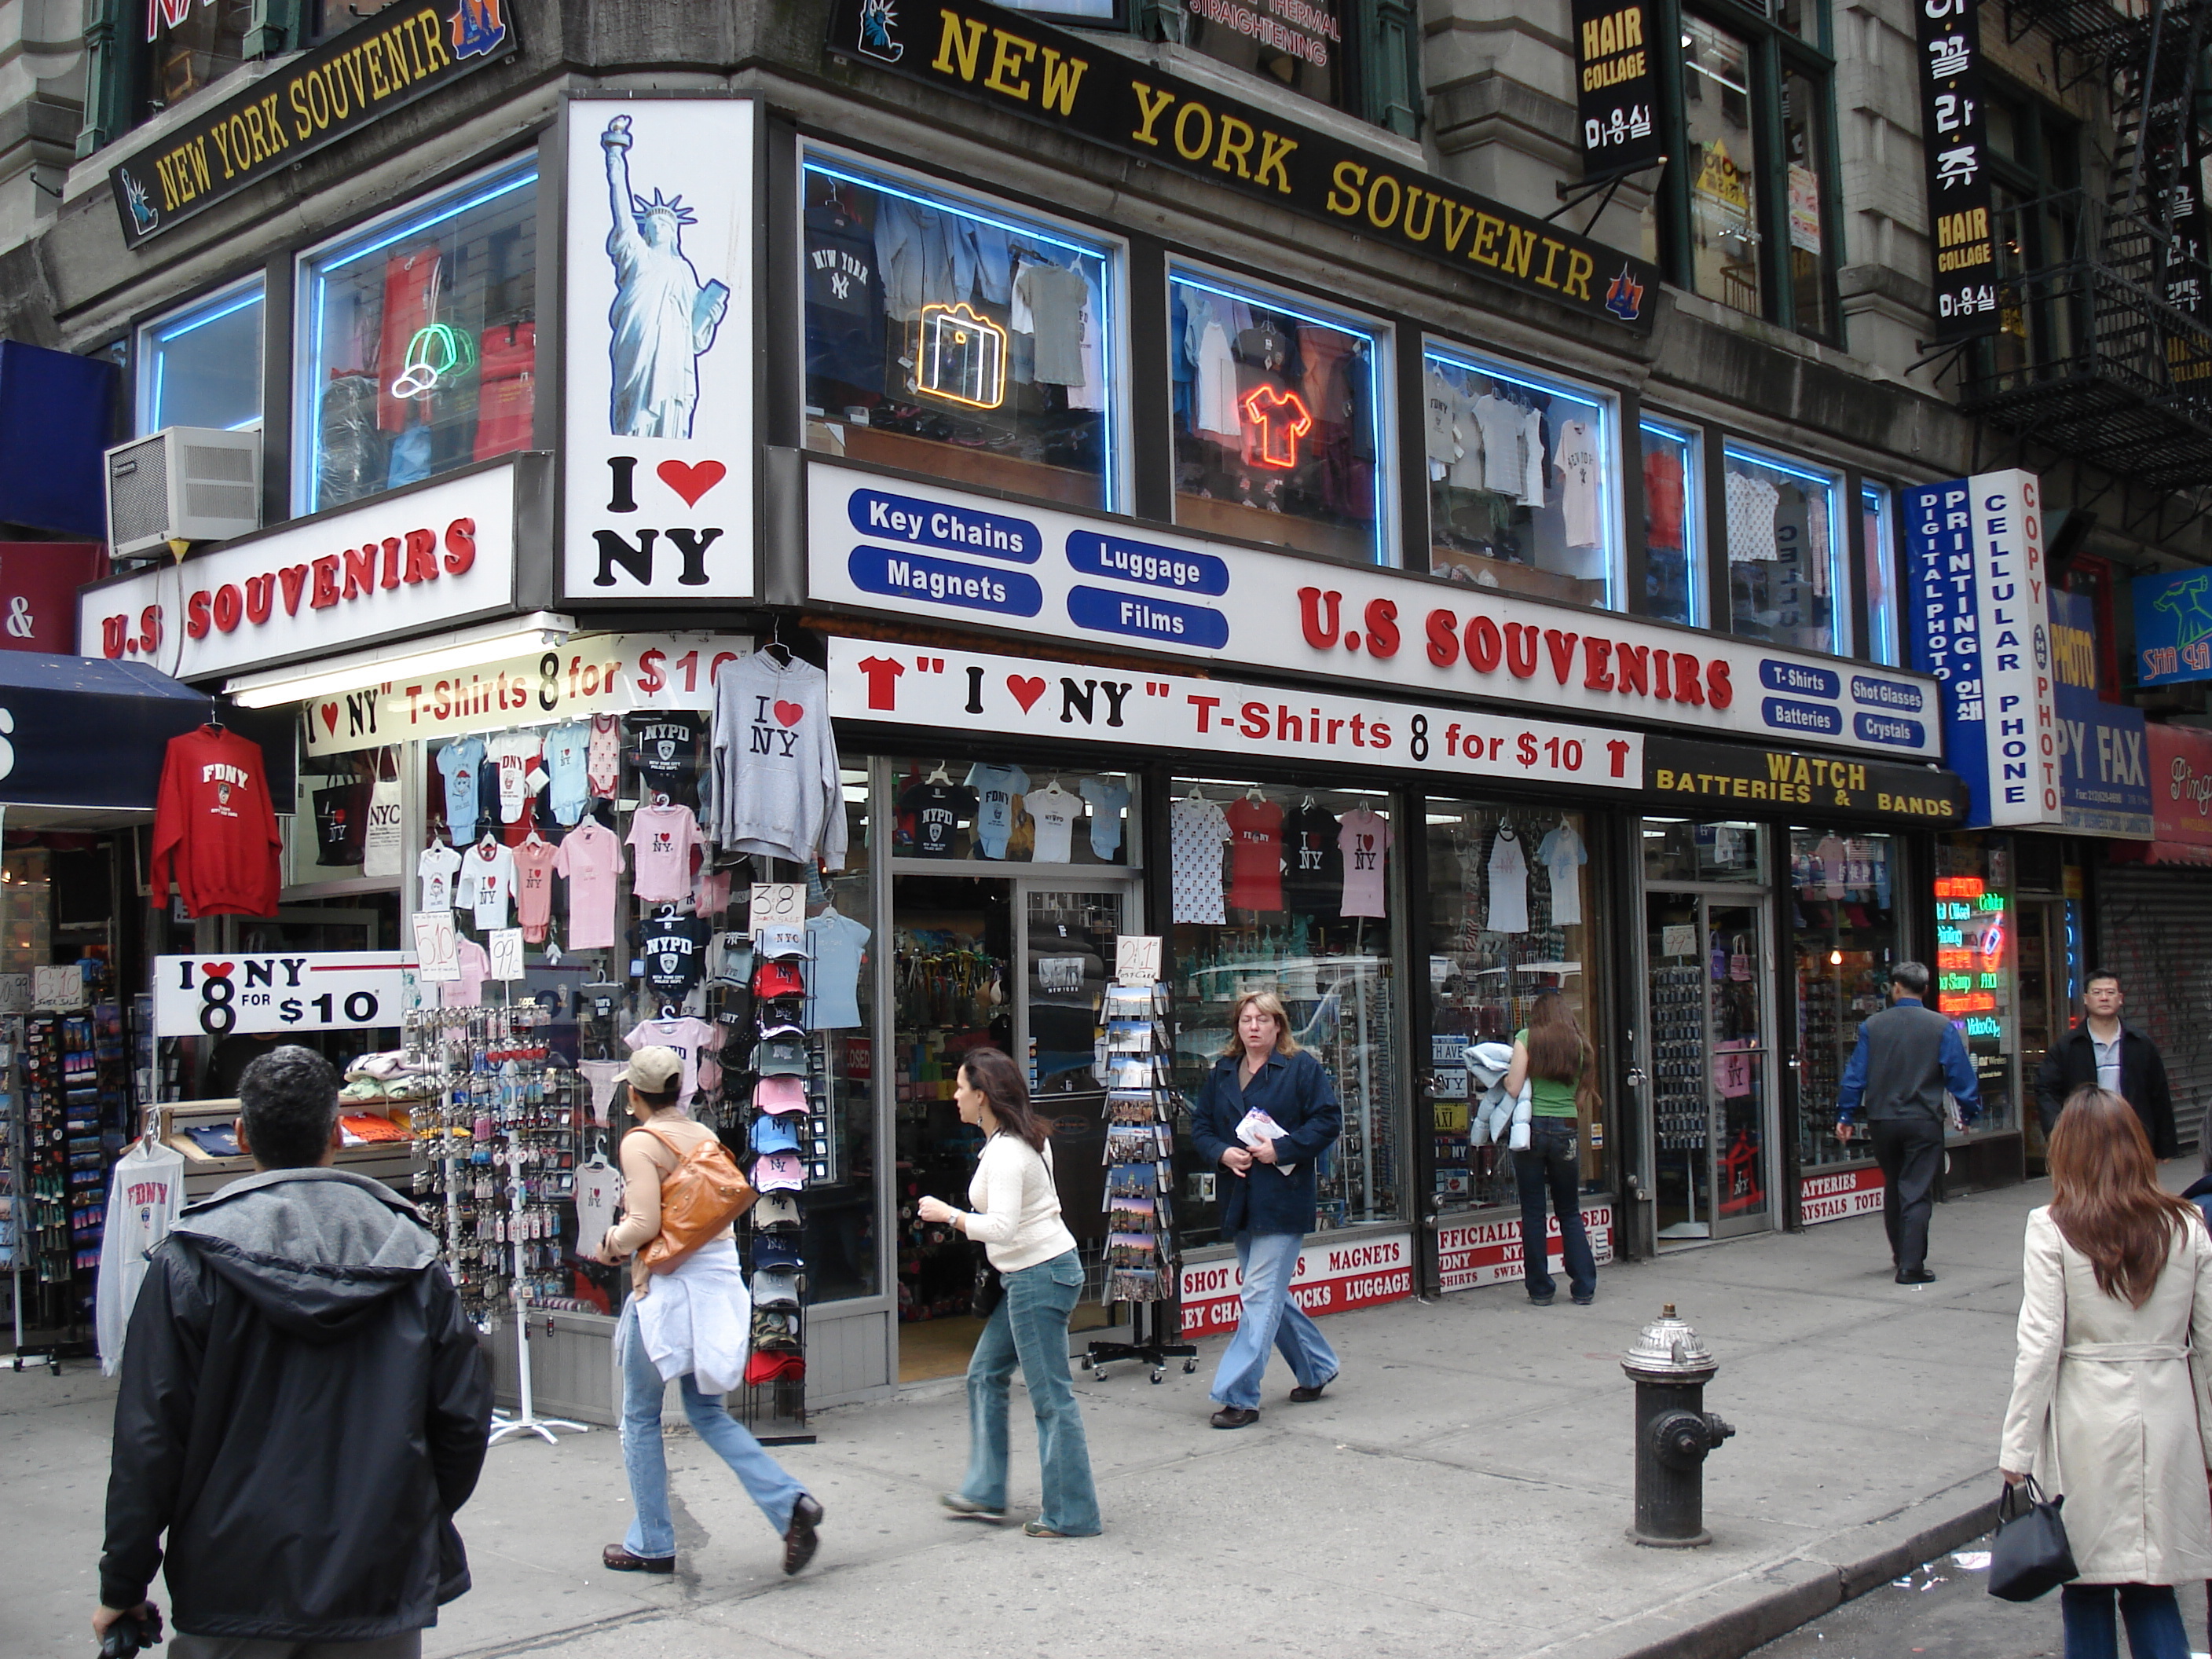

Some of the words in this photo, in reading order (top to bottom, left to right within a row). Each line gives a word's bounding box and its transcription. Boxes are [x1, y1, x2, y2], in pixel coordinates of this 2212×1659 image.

[1583, 7, 1643, 61] HAIR
[1584, 50, 1646, 93] COLLAGE
[156, 135, 212, 211] NEW
[211, 93, 288, 179] YORK
[290, 9, 449, 141] SOUVENIR
[1585, 104, 1651, 149] 미용실
[932, 9, 1088, 116] NEW
[1131, 82, 1298, 194] YORK
[1327, 161, 1594, 302] SOUVENIR
[1938, 207, 1989, 248] HAIR
[1938, 243, 1991, 273] COLLAGE
[1939, 284, 1996, 317] 미용실
[606, 456, 638, 513] I
[870, 500, 923, 540] Key
[931, 512, 1024, 554] Chains
[2023, 482, 2041, 604] COPY
[591, 528, 723, 586] NY
[1101, 542, 1201, 587] Luggage
[1945, 490, 1978, 655] PRINTING
[103, 603, 163, 659] U.S
[188, 517, 475, 639] SOUVENIRS
[888, 558, 1007, 603] Magnets
[1984, 494, 2020, 672] CELLULAR
[1120, 602, 1185, 635] Films
[1298, 586, 1401, 660] U.S
[1426, 608, 1733, 709] SOUVENIRS
[2050, 623, 2095, 690] PHOTO
[406, 669, 528, 726] T-Shirts
[538, 651, 560, 712] 8
[569, 655, 621, 698] for
[1853, 681, 1878, 701] Shot
[1881, 685, 1921, 709] Glasses
[754, 695, 771, 723] I
[1775, 705, 1831, 729] Batteries
[644, 723, 690, 742] NYPD
[749, 725, 800, 758] NY
[1187, 695, 1393, 749] T-Shirts
[1410, 713, 1429, 762] 8
[1445, 723, 1504, 761] for
[1516, 731, 1583, 772] $10
[1866, 718, 1910, 741] Crystals
[1999, 694, 2027, 804] PHONE
[2037, 676, 2056, 811] PHOTO
[501, 755, 522, 771] DNY
[1766, 753, 1866, 791] WATCH
[2097, 723, 2145, 787] FAX
[203, 763, 249, 789] FDNY
[1657, 769, 1811, 804] BATTERIES
[1834, 789, 1851, 807] &
[1878, 793, 1953, 817] BANDS
[369, 804, 401, 826] NYC
[922, 808, 954, 826] NYPD
[985, 790, 1009, 805] FDNY
[1299, 850, 1323, 870] NY
[1354, 851, 1376, 870] NY
[646, 936, 694, 956] NYPD
[178, 960, 195, 990] I
[244, 958, 307, 989] NY
[200, 976, 236, 1035] 8
[242, 994, 271, 1006] FOR
[280, 991, 379, 1025] $10
[1434, 1111, 1452, 1128] AXI
[127, 1182, 167, 1210] FDNY
[1801, 1173, 1857, 1199] ATTERIES
[1801, 1199, 1847, 1221] RYSTALS
[1855, 1192, 1882, 1210] TOTE
[1440, 1221, 1523, 1249] FFICIALLY
[1184, 1268, 1228, 1294] SHOT
[1329, 1242, 1400, 1273] MAGNETS
[1293, 1286, 1331, 1309] OCKS
[1345, 1272, 1411, 1302] LUGGAGE
